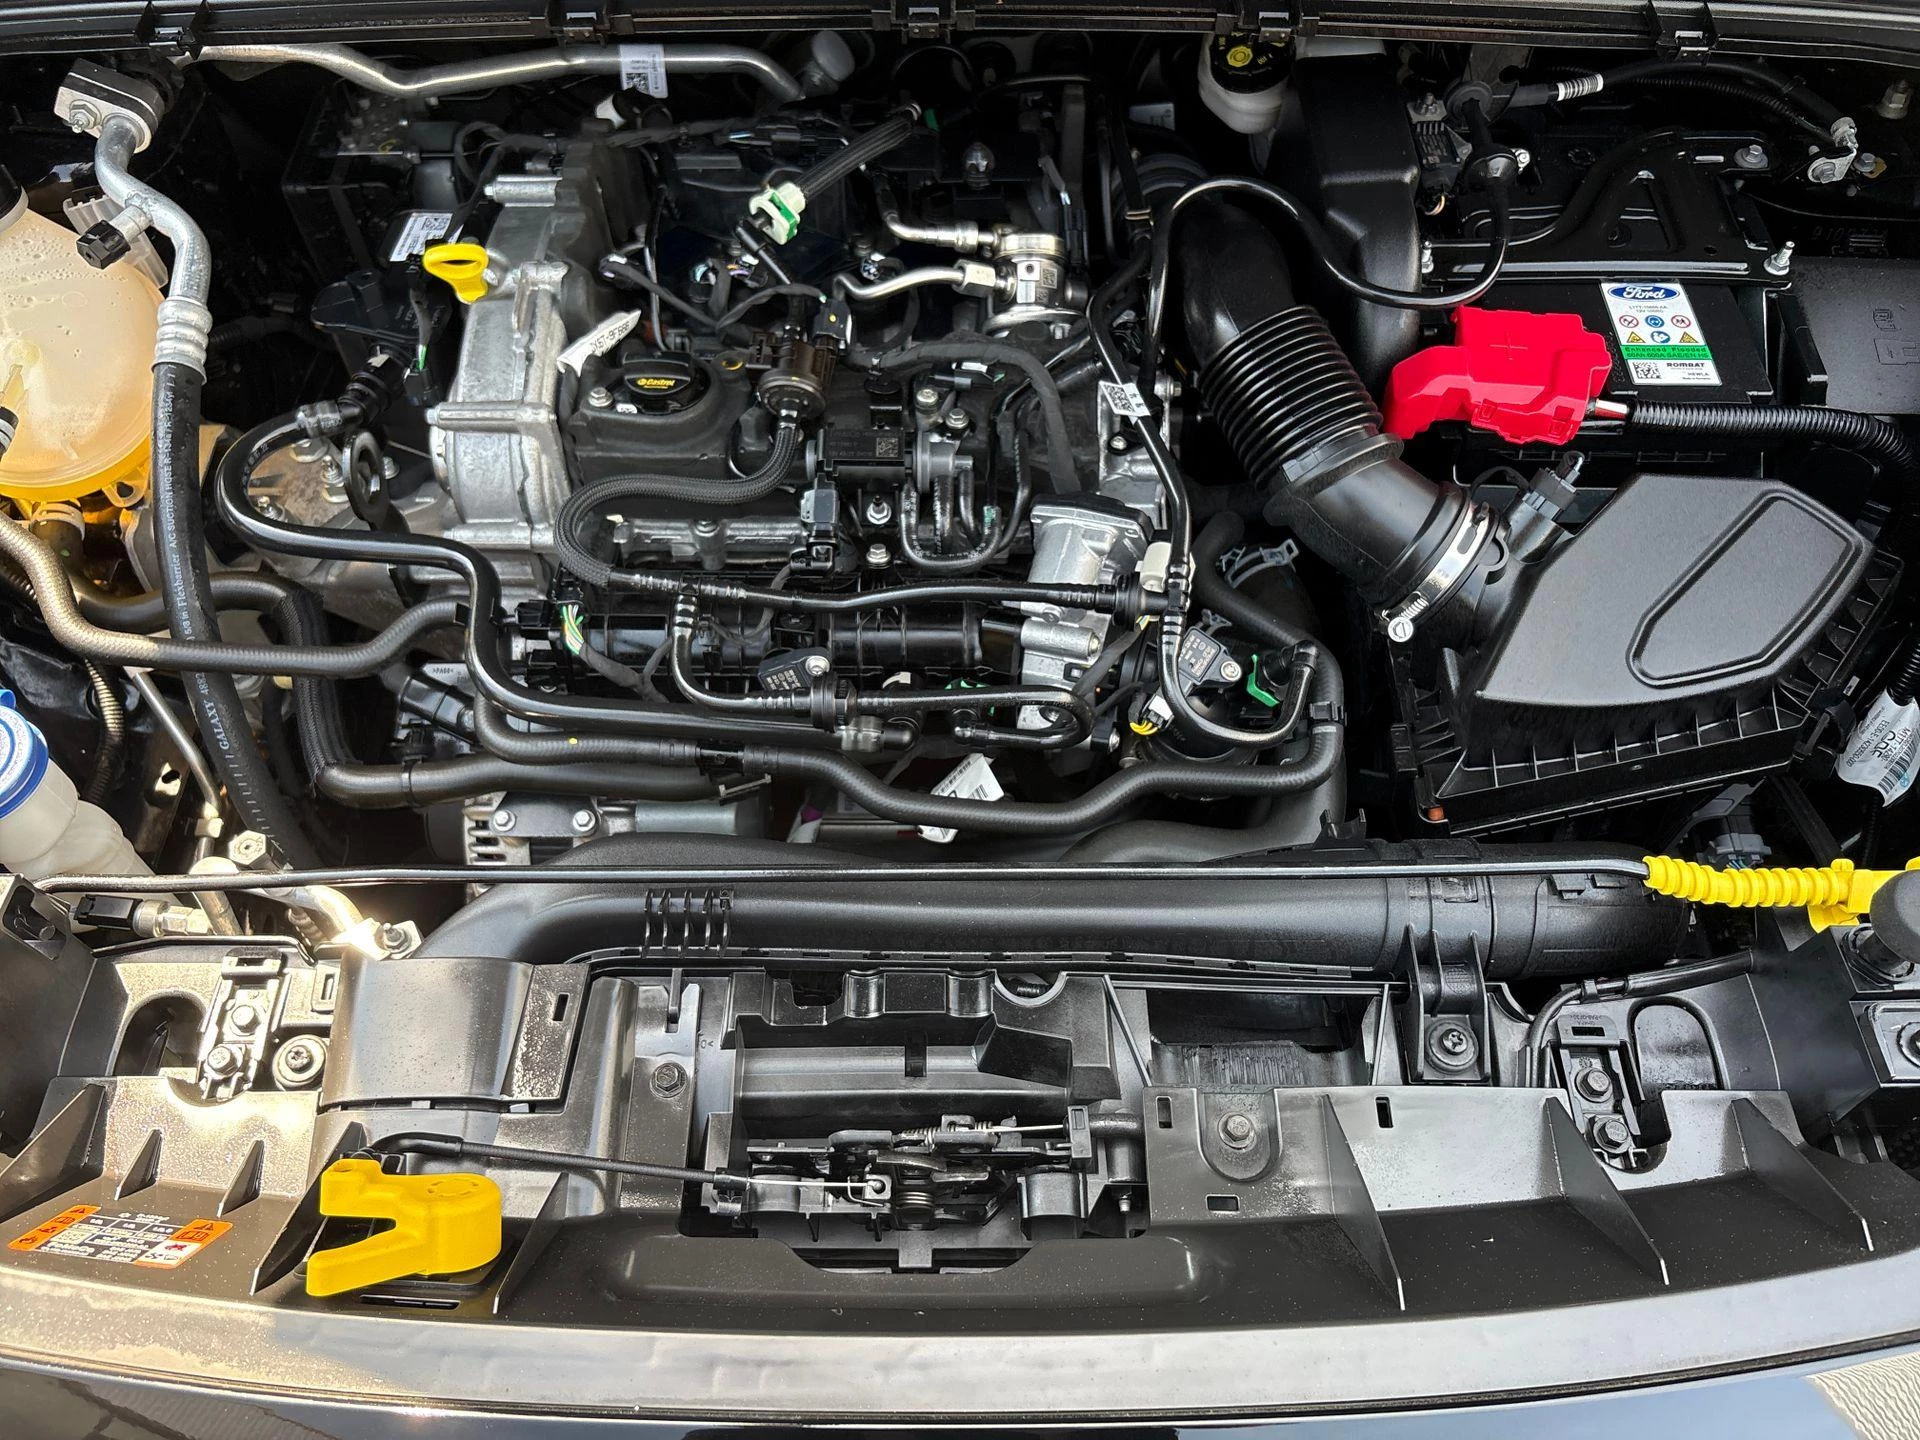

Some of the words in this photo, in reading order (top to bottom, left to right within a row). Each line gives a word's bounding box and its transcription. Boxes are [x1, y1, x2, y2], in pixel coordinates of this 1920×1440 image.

[1622, 286, 1666, 299] Ford
[646, 379, 675, 387] Castrol
[164, 492, 176, 533] SUCTION
[167, 532, 177, 549] A/C
[171, 554, 188, 608] Flexbarrier
[204, 699, 230, 750] GALAXY
